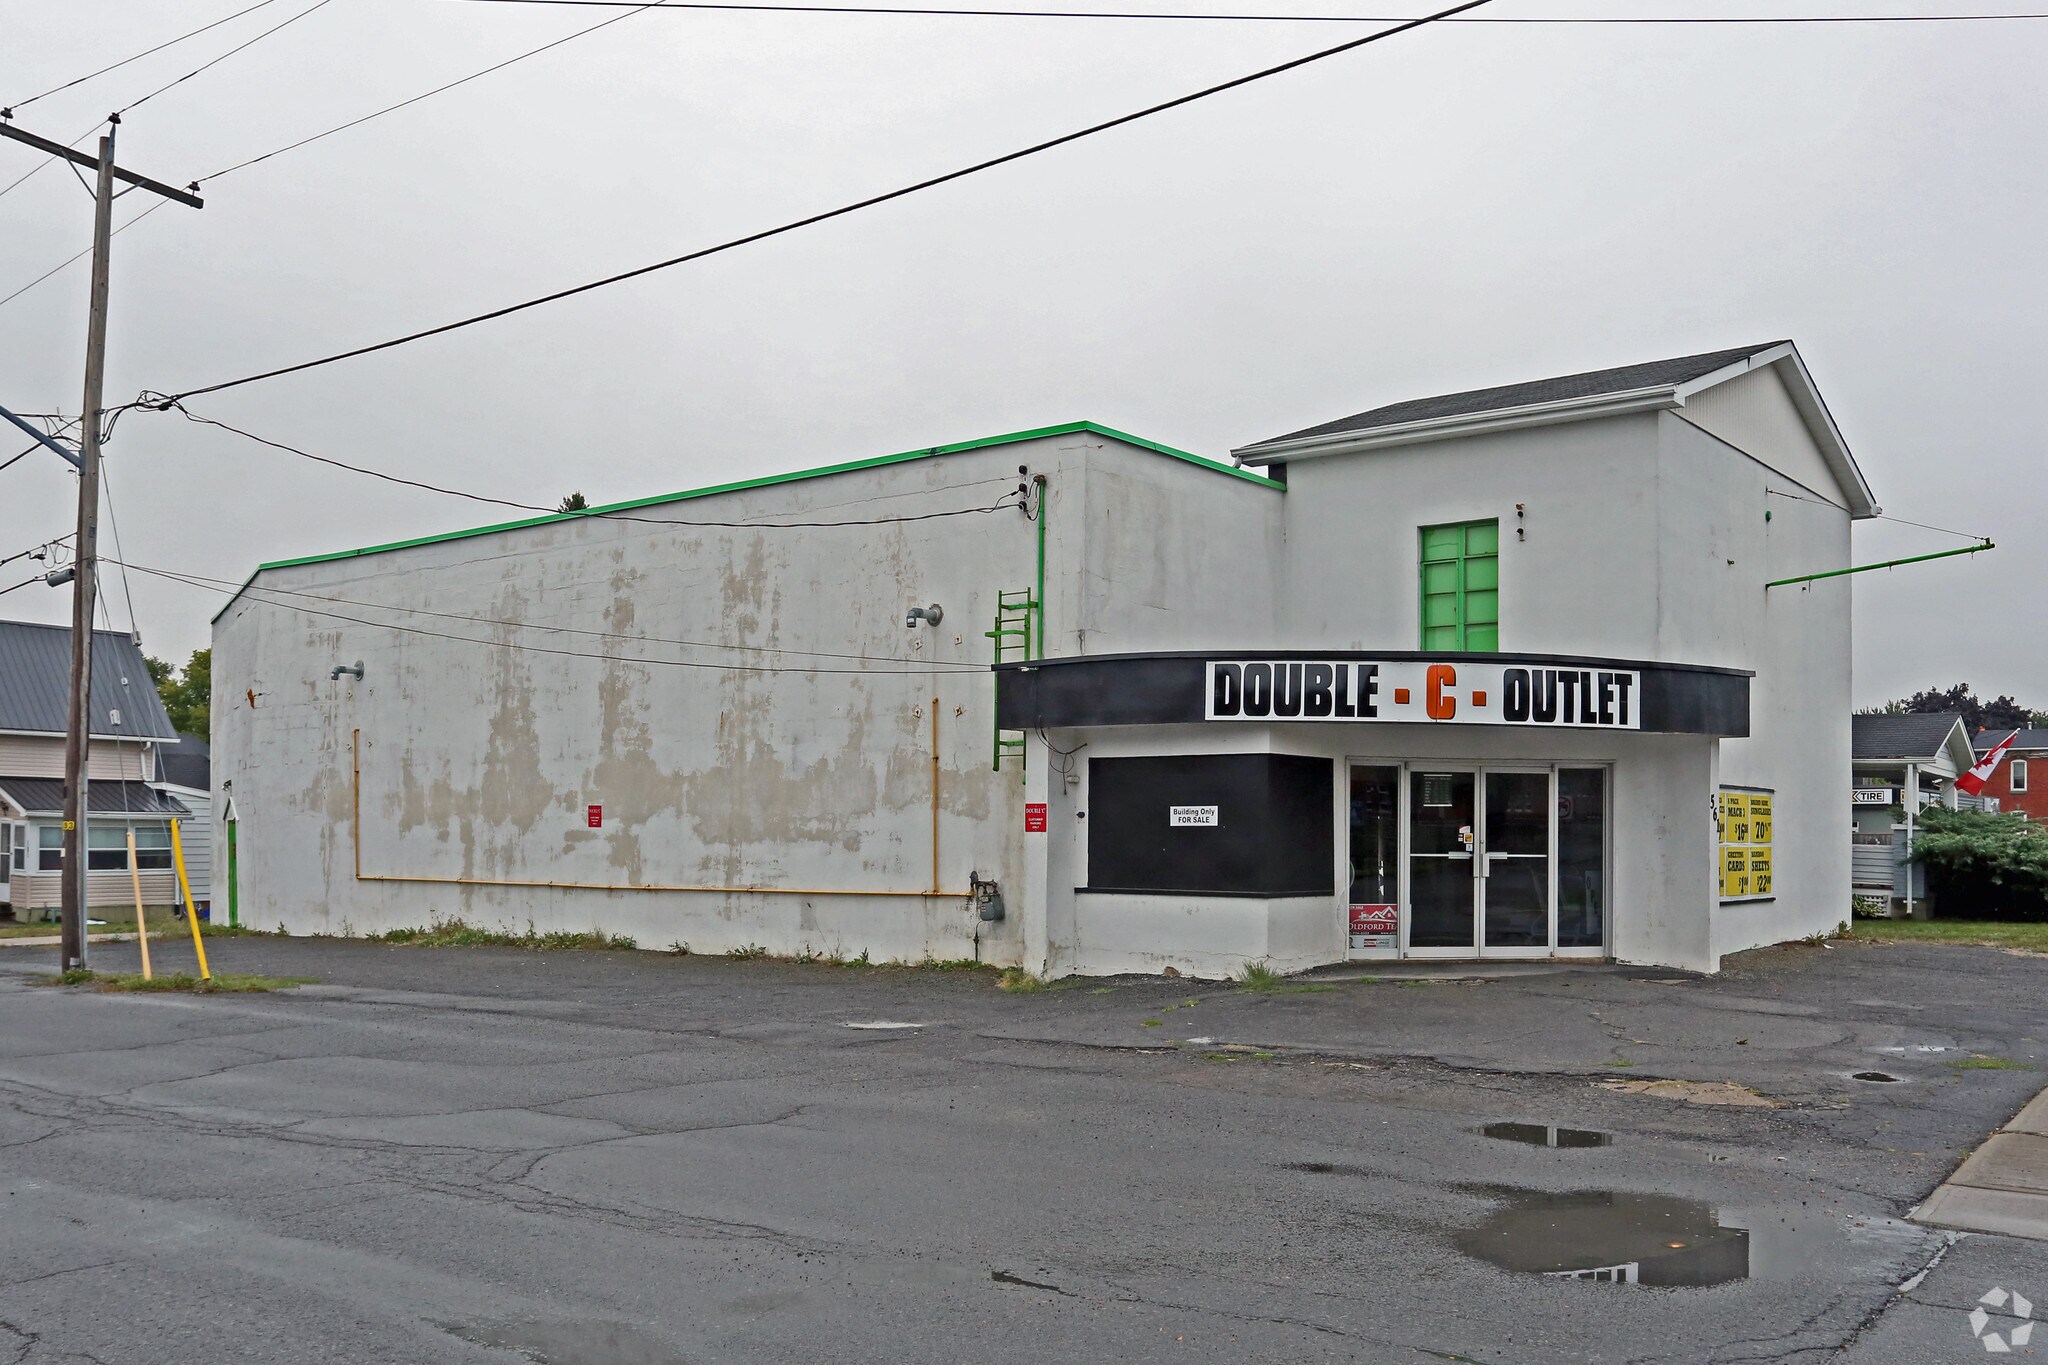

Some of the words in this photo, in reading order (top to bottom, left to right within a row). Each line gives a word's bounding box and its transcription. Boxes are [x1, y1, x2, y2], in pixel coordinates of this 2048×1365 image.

[1213, 663, 1378, 718] DOUBLE
[1503, 667, 1633, 726] OUTLET
[1861, 792, 1883, 800] TIRE
[1173, 808, 1199, 817] Building
[1200, 808, 1216, 817] Only
[1727, 806, 1742, 818] MACH
[1727, 860, 1745, 872] CARDS
[1751, 860, 1770, 872] SHEETS
